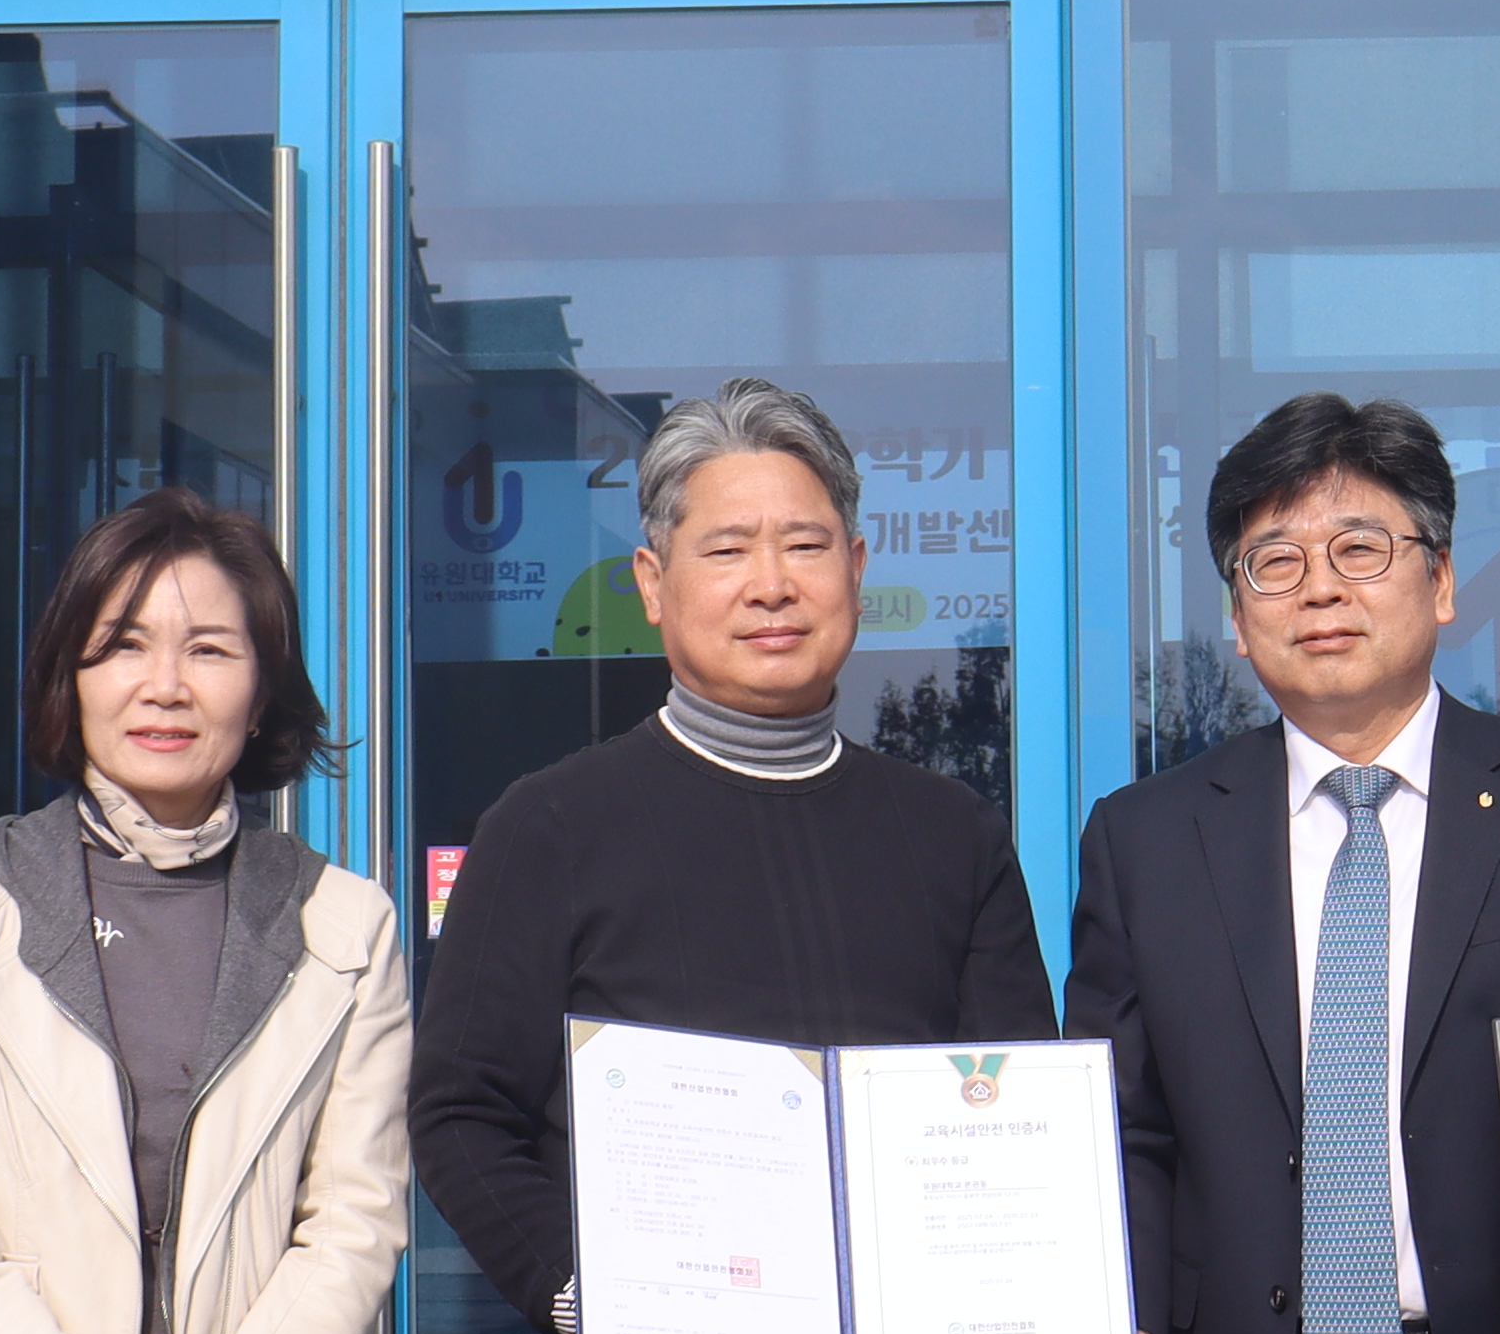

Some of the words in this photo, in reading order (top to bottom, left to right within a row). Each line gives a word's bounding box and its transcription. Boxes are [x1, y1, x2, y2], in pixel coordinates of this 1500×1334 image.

[420, 560, 546, 585] 유원대학교
[446, 588, 545, 603] UNIVERSITY
[923, 1121, 1003, 1138] 교육시설안전
[1008, 1120, 1048, 1136] 인증서
